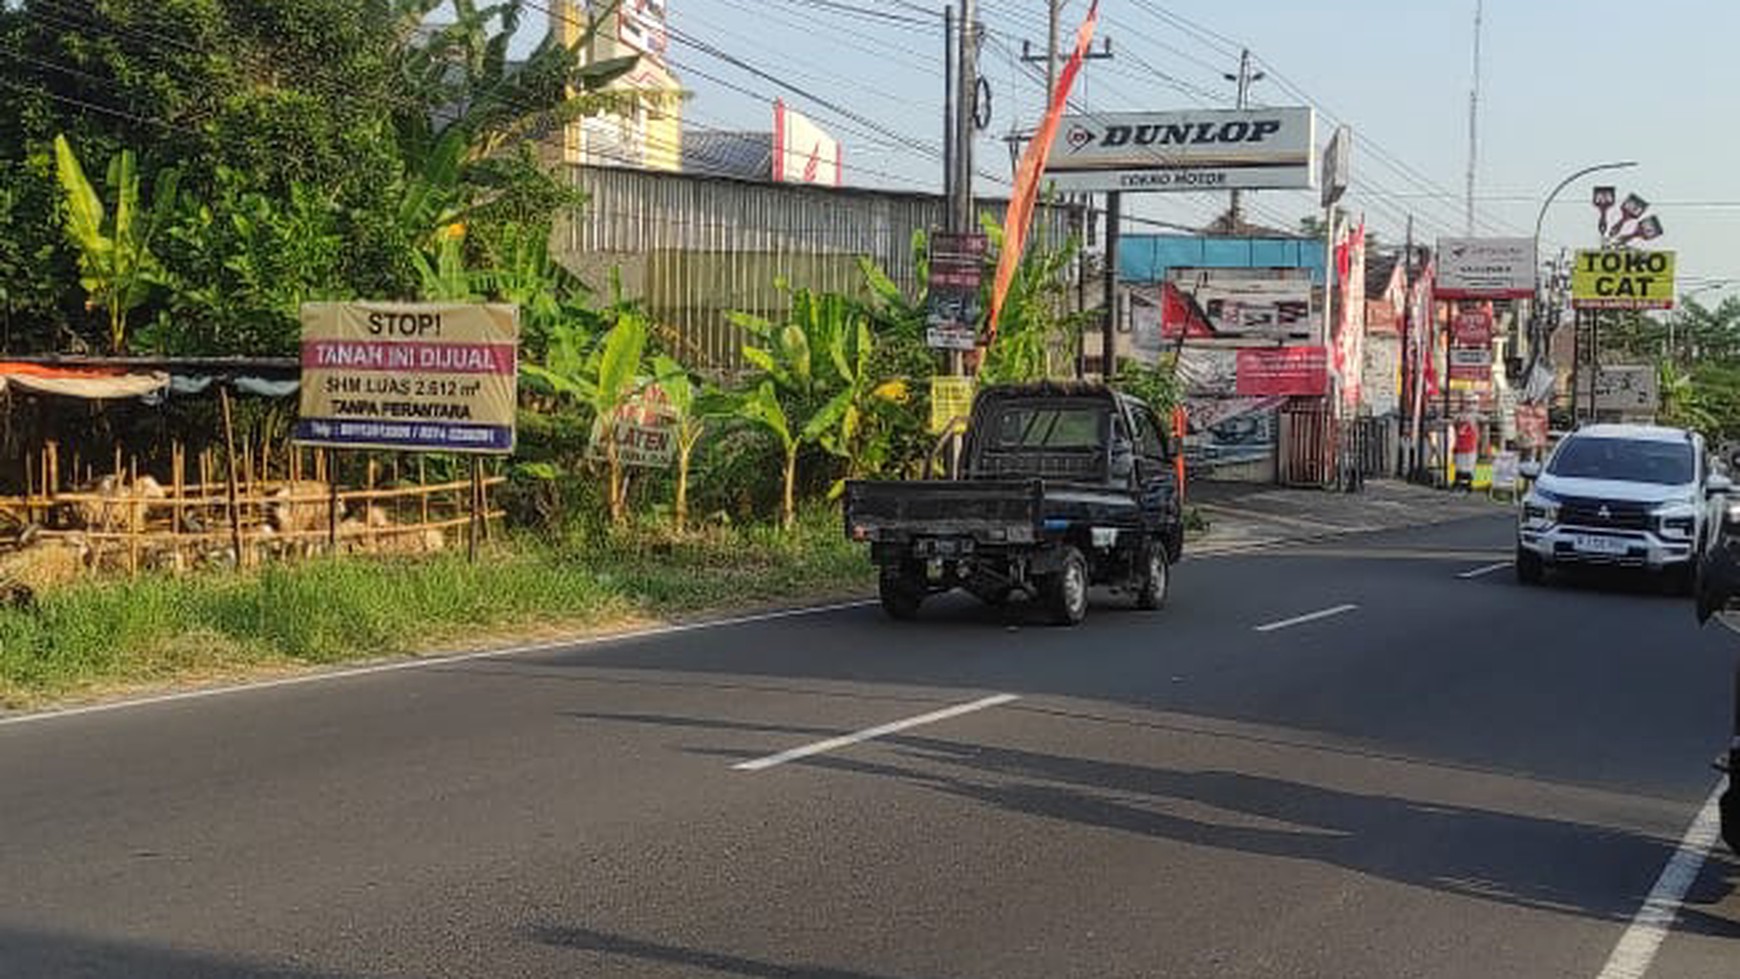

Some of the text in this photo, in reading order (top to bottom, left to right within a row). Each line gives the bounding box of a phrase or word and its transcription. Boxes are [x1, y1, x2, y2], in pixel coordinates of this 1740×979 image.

[1101, 119, 1281, 148] DUNLOP
[1582, 253, 1666, 273] TOKO
[1595, 276, 1655, 297] CAT
[368, 313, 442, 336] STOP!
[315, 345, 496, 370] TANAH INI DIJUAL
[326, 376, 361, 393] SHM
[366, 378, 410, 395] LUAS
[331, 399, 471, 419] TANPA PERANTARA
